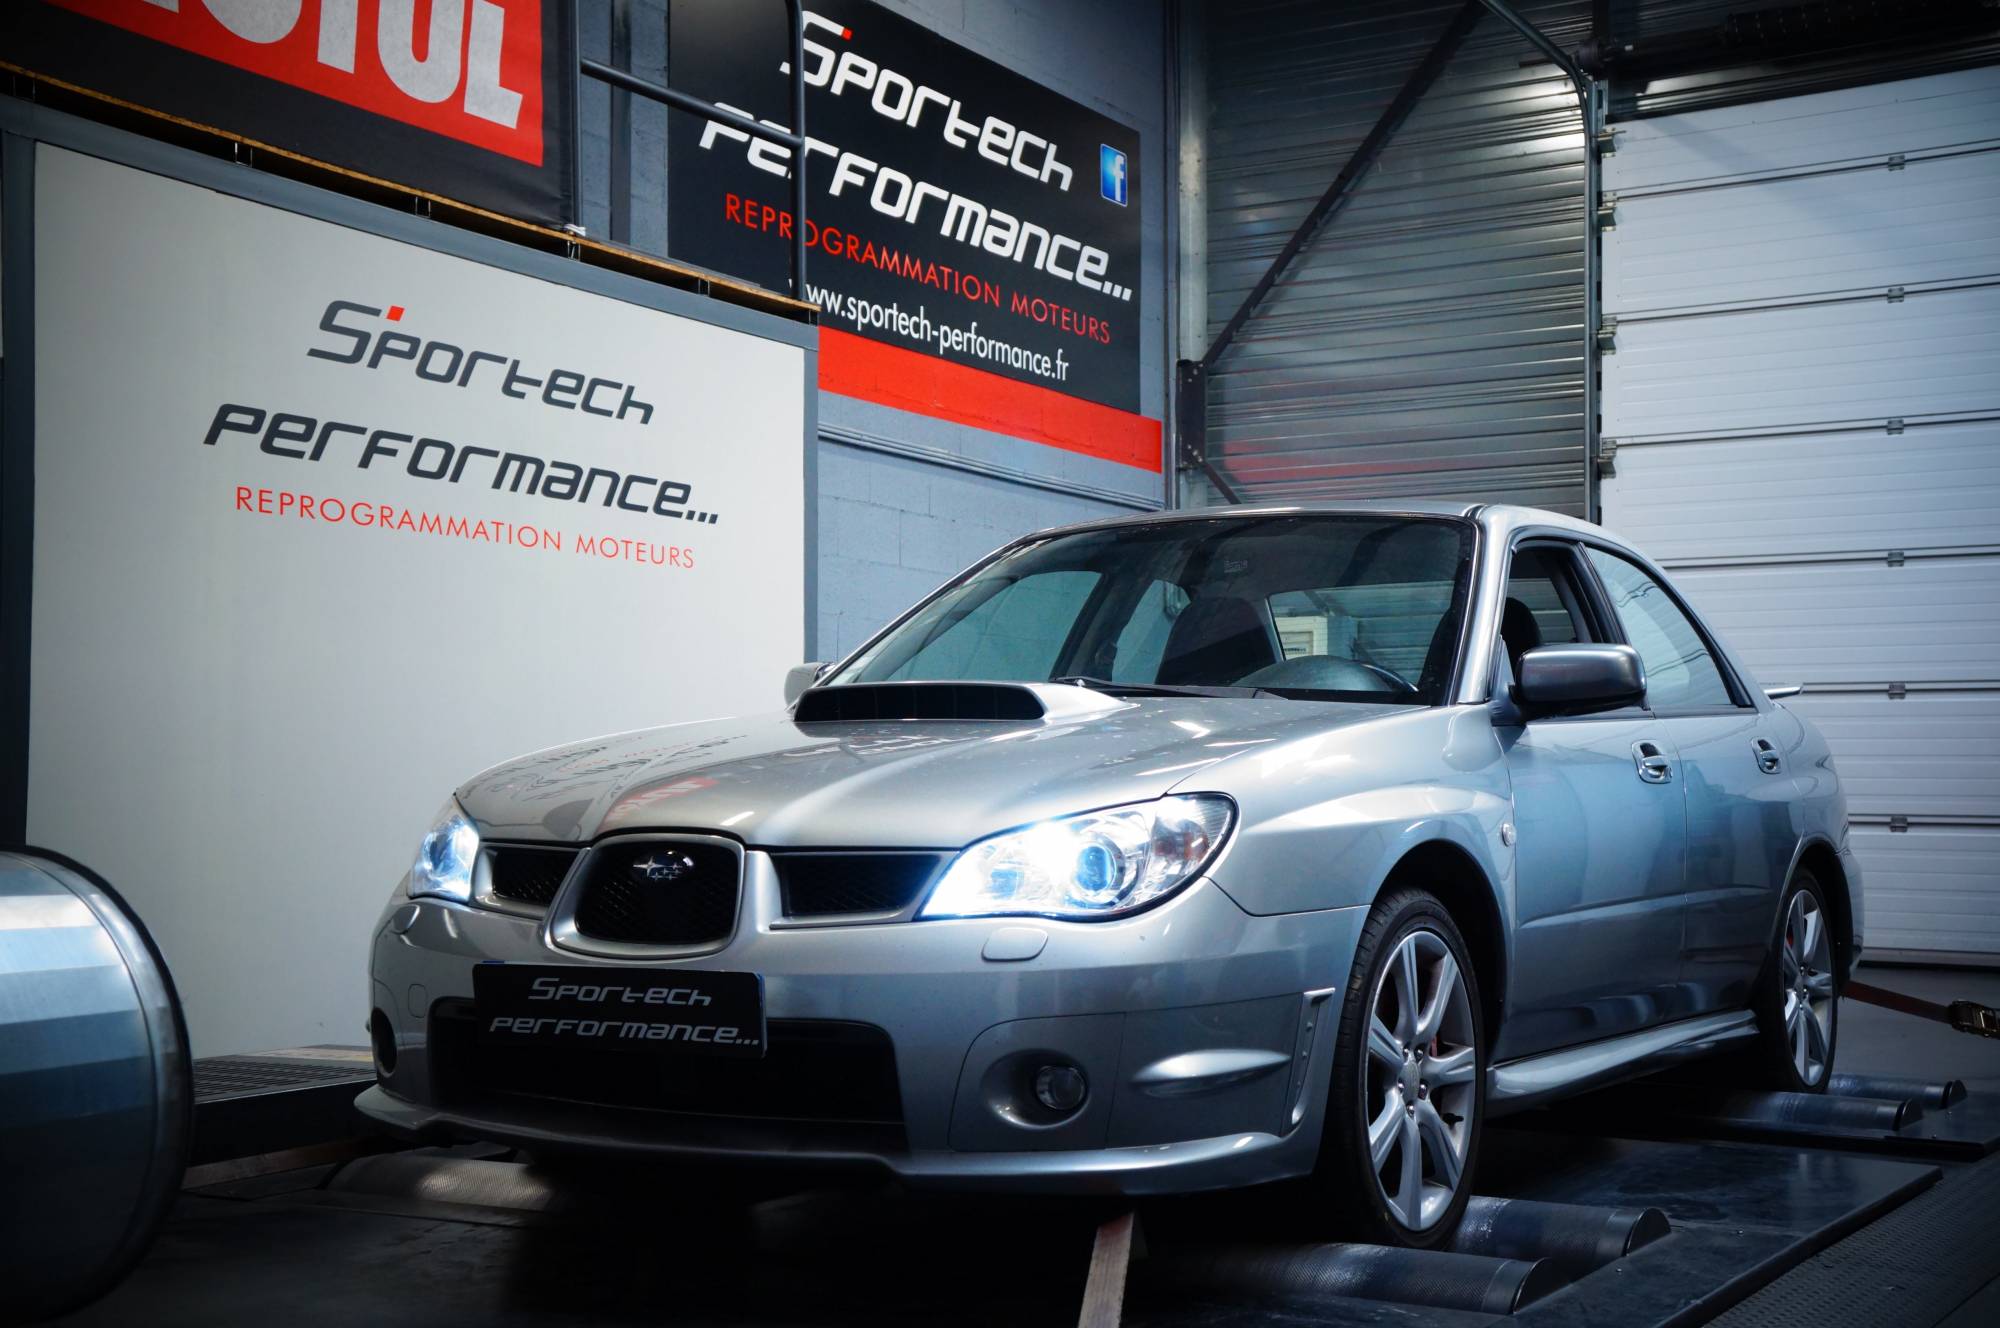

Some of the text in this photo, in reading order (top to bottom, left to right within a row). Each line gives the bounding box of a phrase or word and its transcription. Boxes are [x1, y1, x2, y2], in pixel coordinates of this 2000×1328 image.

[788, 278, 1069, 381] ww.sportech-performance.fr
[1011, 291, 1111, 344] MOTEURS
[235, 486, 694, 569] REPROGRAMMATION MOTEURS
